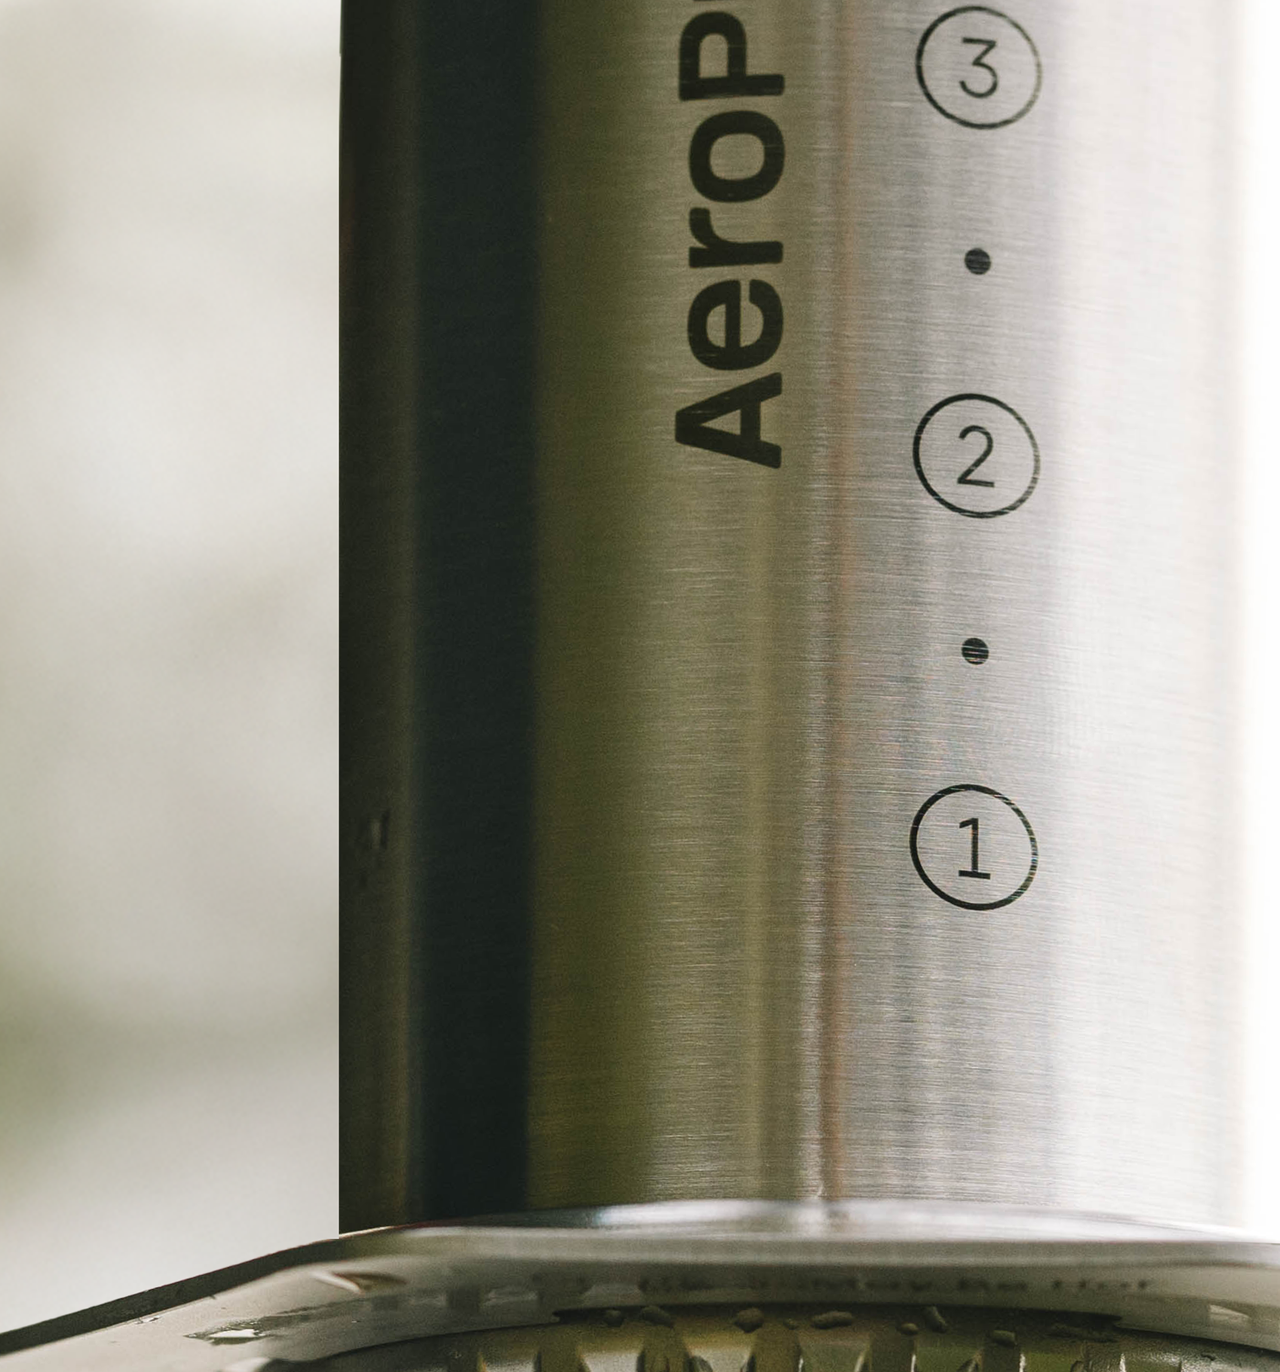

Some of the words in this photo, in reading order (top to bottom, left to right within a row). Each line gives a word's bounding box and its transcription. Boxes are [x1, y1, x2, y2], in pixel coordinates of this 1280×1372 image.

[958, 36, 999, 100] 3
[674, 0, 786, 470] AeroP
[955, 424, 996, 489] 2
[958, 816, 992, 881] 1
